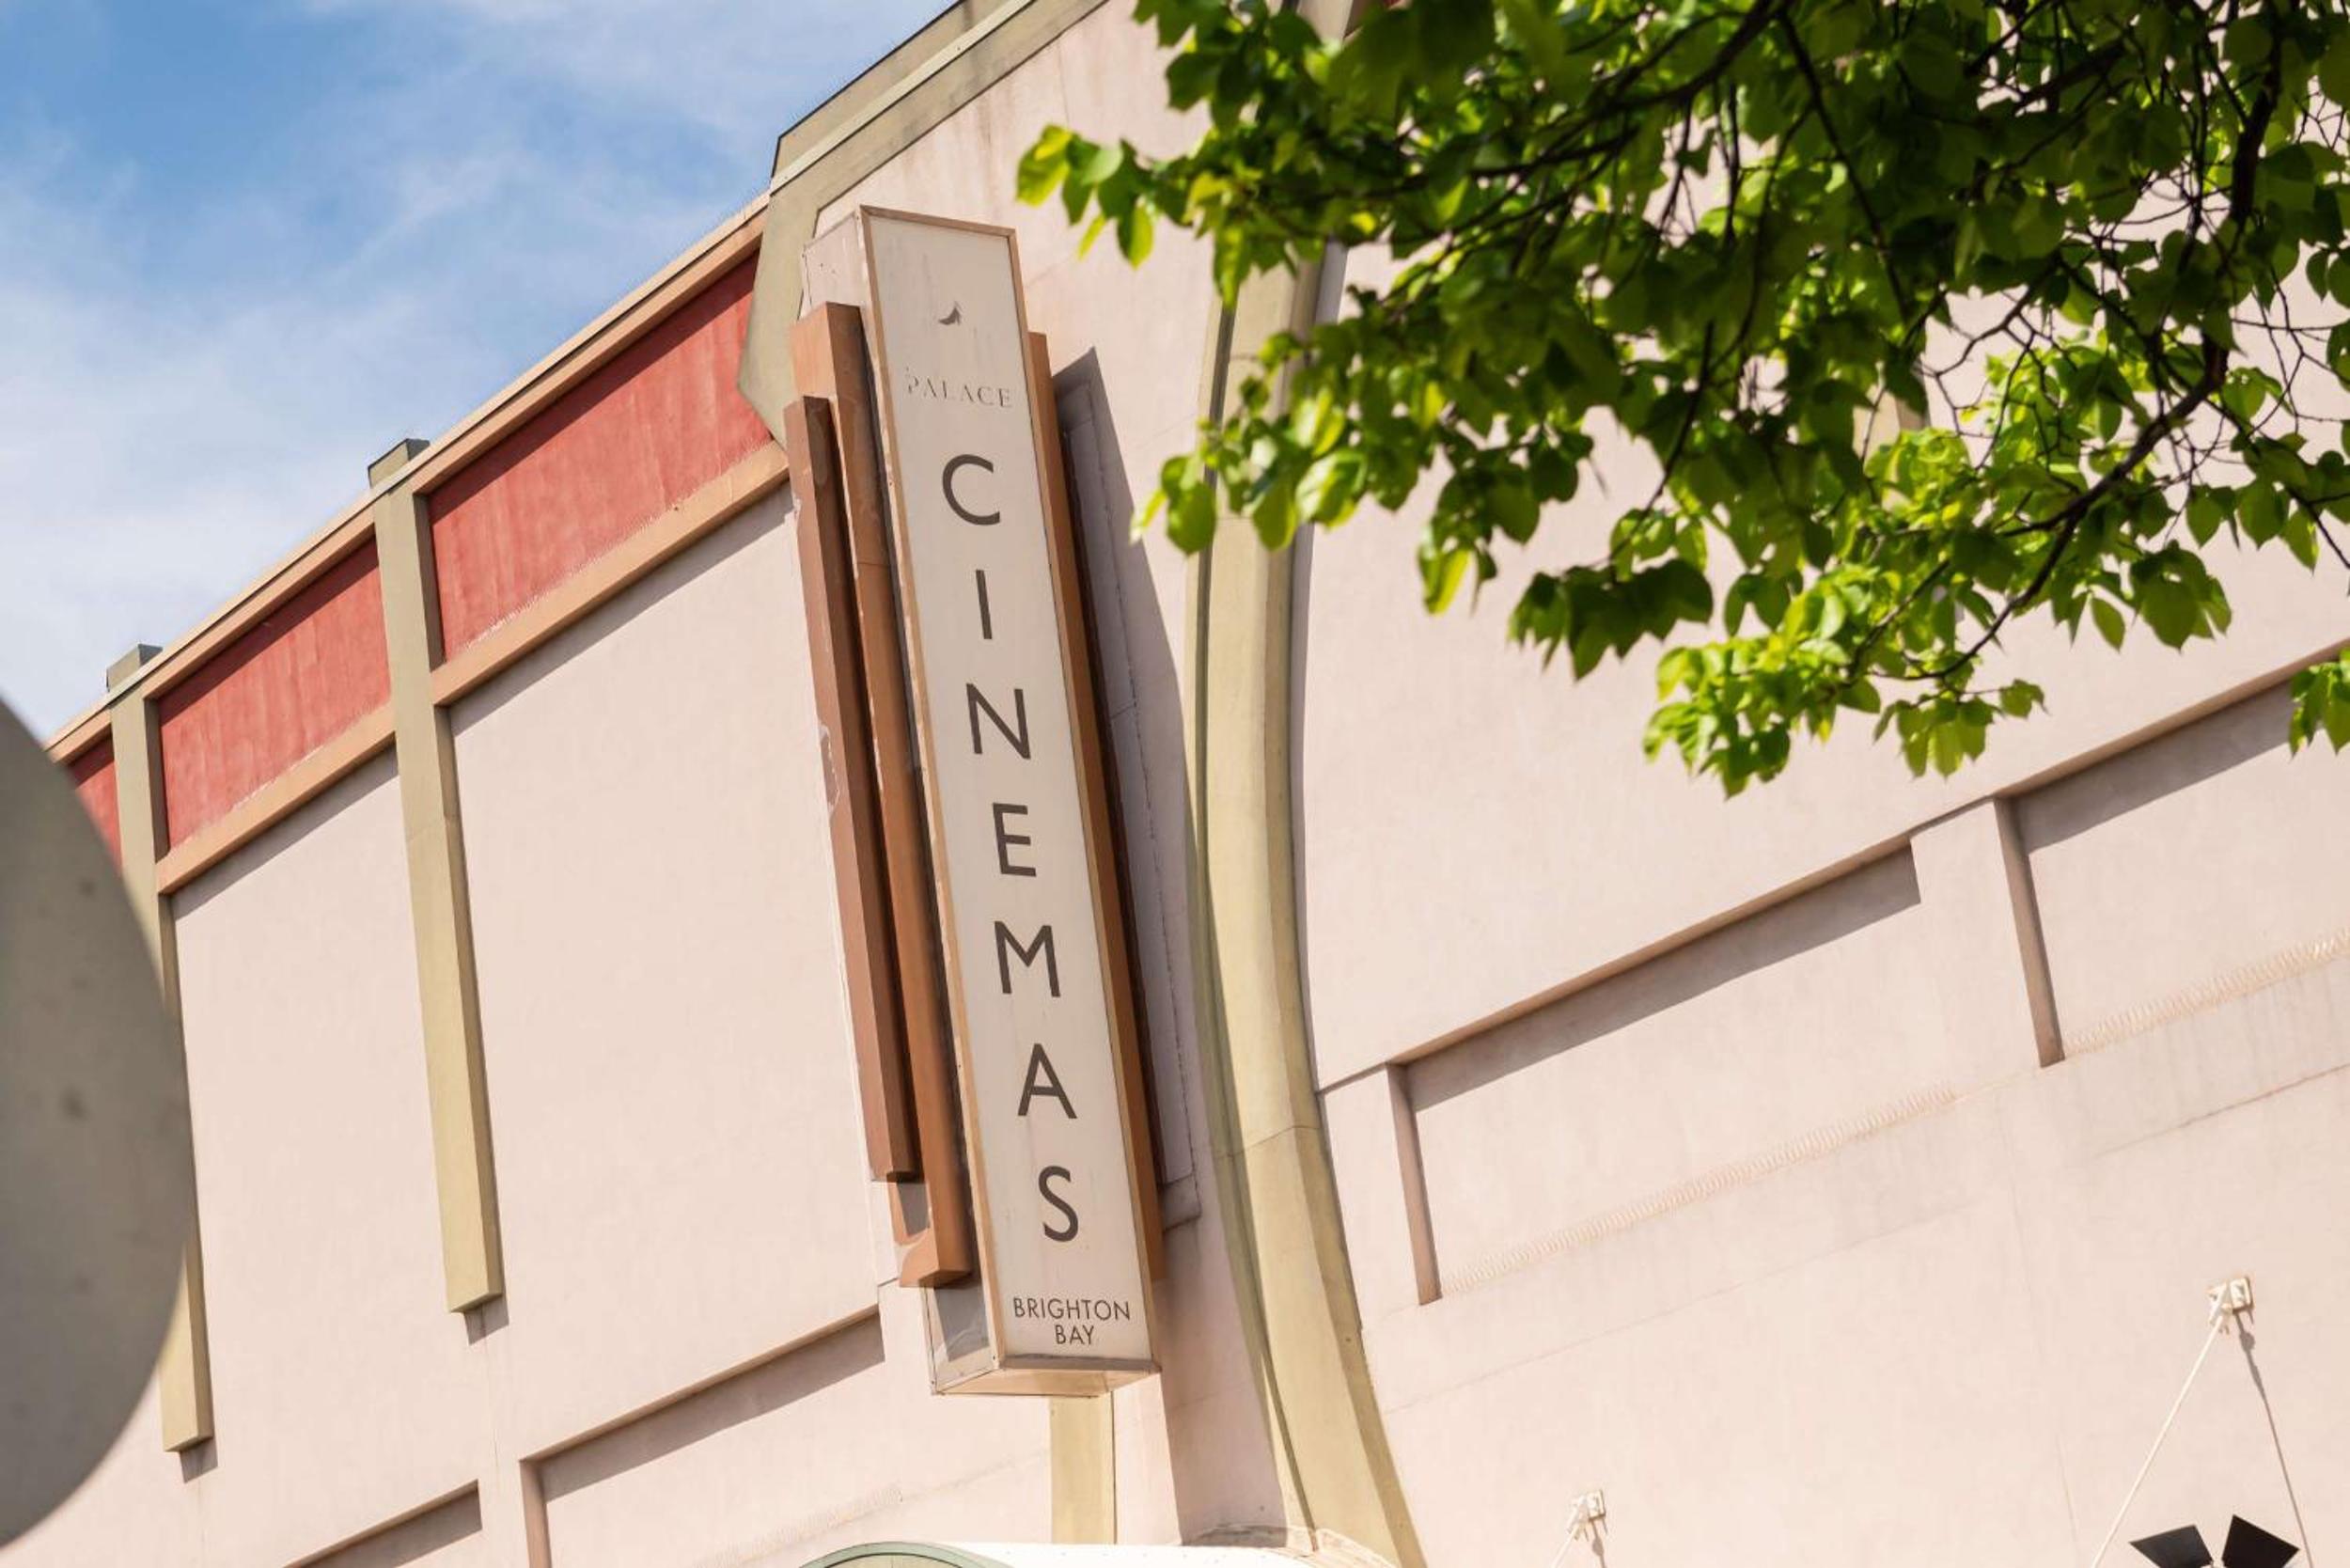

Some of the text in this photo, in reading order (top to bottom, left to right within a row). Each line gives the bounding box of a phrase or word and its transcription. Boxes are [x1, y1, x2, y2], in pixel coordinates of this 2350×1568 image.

[907, 376, 1013, 408] PALACE
[942, 454, 1079, 1242] CINEMAS
[1013, 1296, 1131, 1321] BRIGHTON
[1054, 1324, 1095, 1345] BAY
